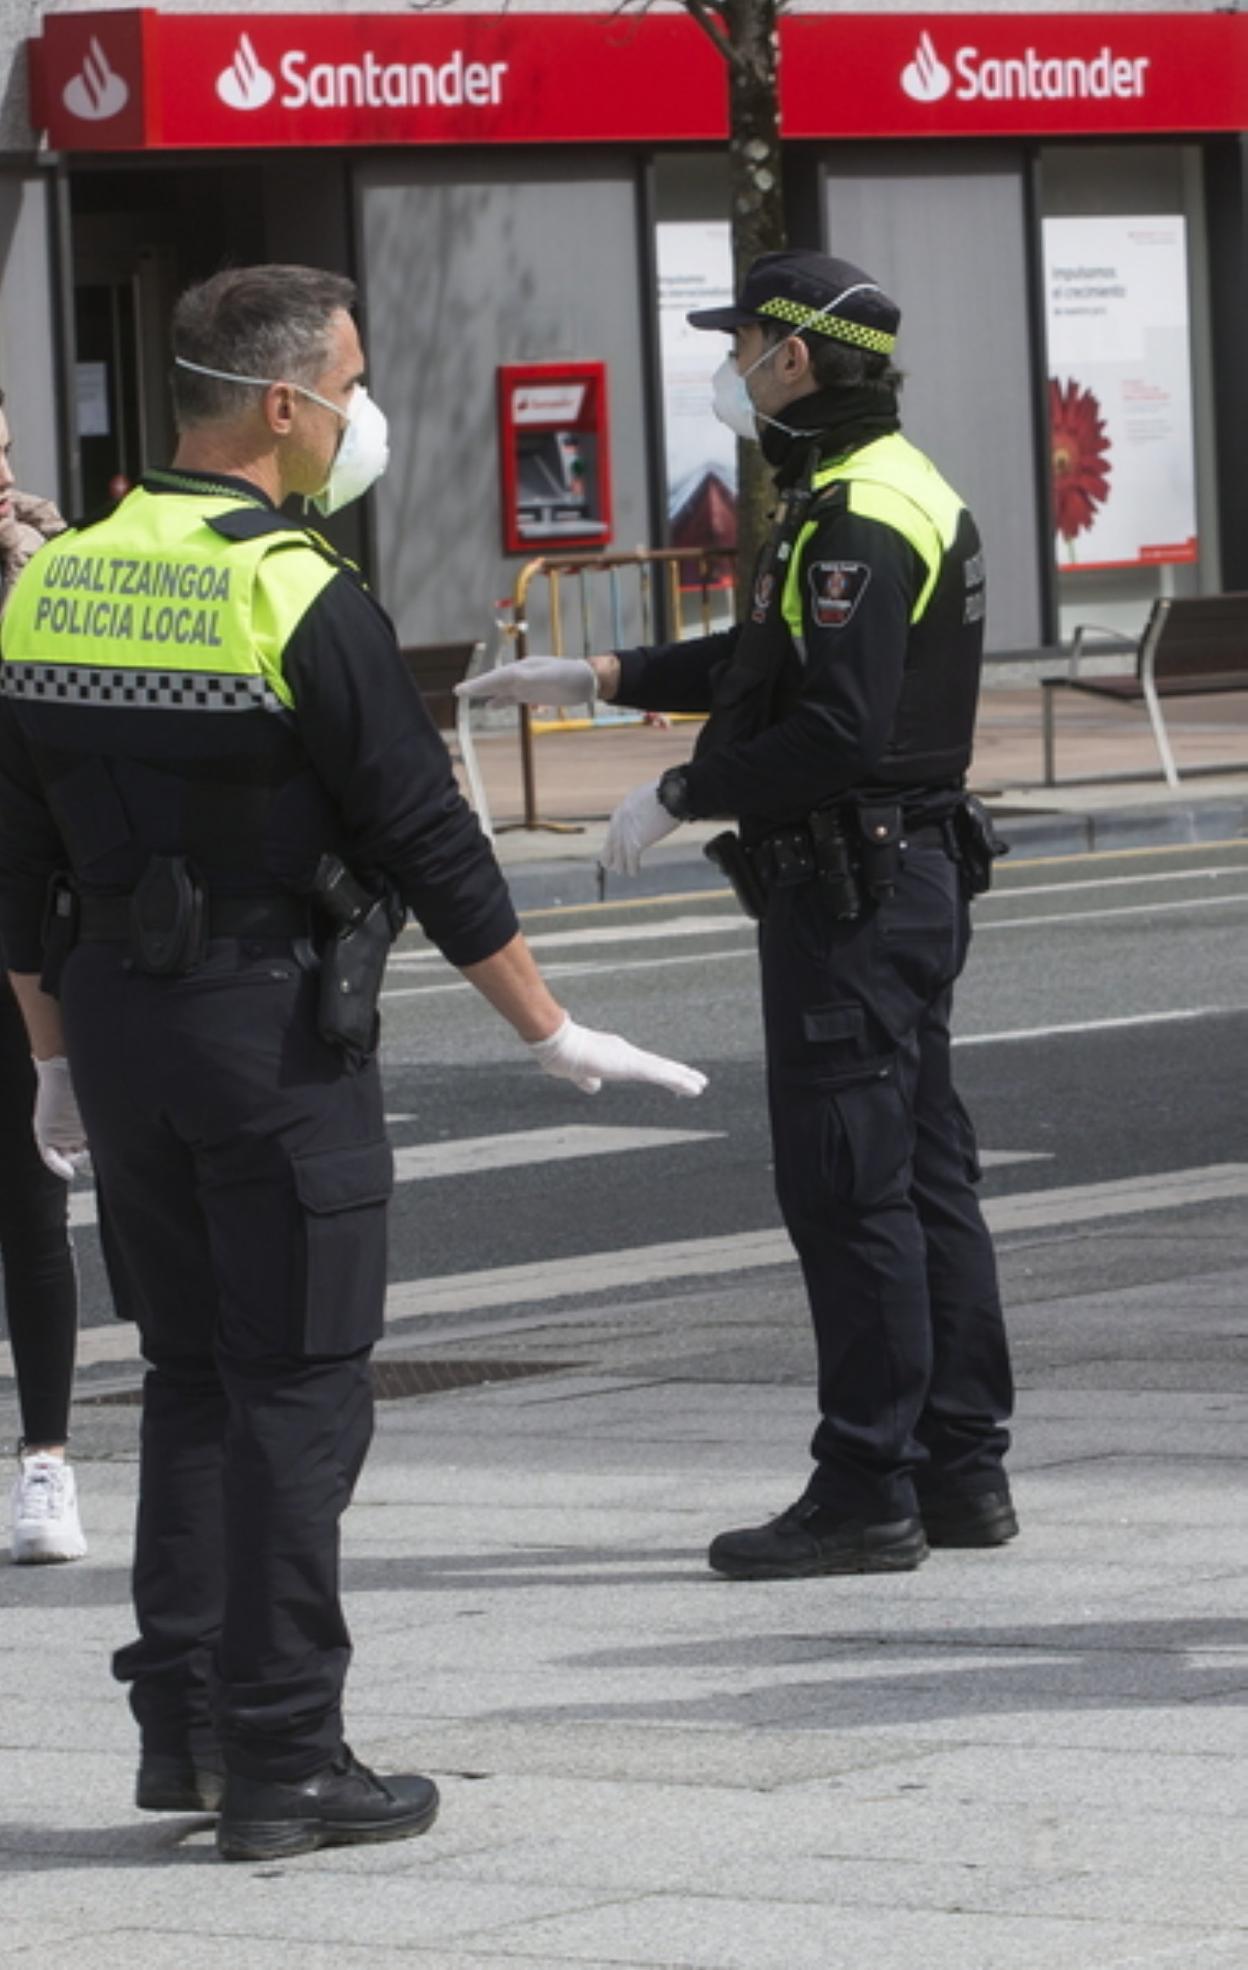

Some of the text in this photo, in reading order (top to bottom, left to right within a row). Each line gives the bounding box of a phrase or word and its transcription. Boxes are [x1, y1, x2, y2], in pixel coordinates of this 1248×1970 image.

[280, 50, 508, 108] Santander
[955, 47, 1150, 101] Santander
[43, 555, 231, 601] UDALTZAINGOA
[34, 597, 222, 646] POLICIA LOCAL
